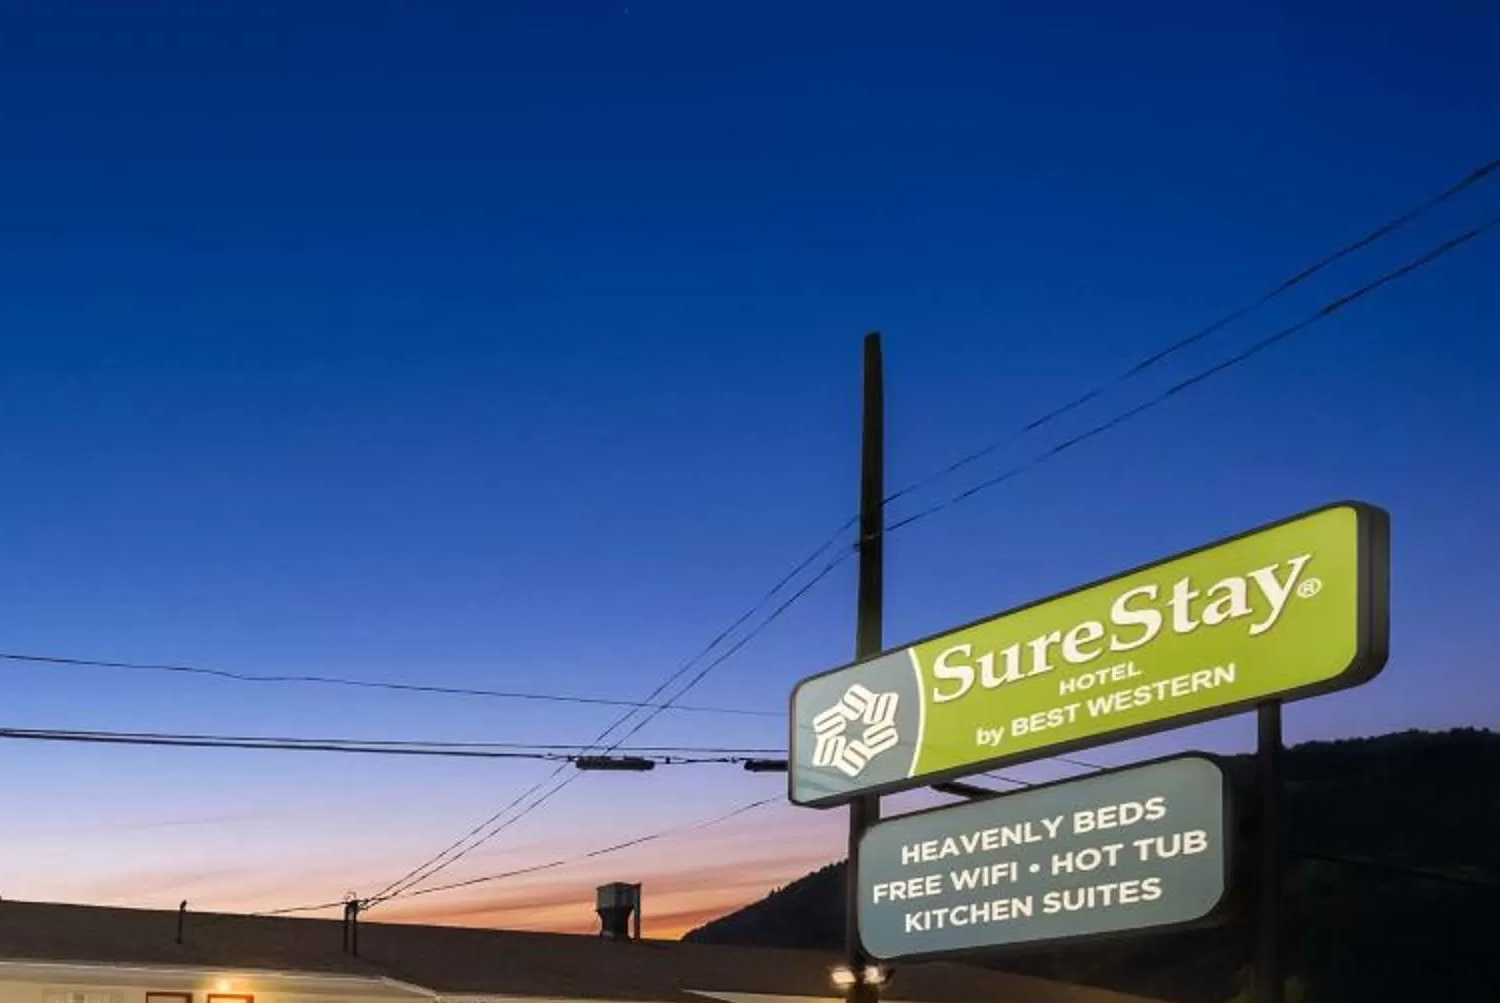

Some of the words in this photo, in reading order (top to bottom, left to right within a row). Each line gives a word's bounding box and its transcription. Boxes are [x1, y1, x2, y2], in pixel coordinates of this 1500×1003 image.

[976, 723, 1005, 747] by
[1011, 703, 1079, 737] BEST
[1088, 662, 1236, 718] WESTERN
[1059, 662, 1141, 696] HOTEL
[901, 816, 1063, 865] HEAVENLY
[1074, 796, 1167, 834] BEDS
[872, 874, 942, 905] FREE
[950, 861, 1018, 893] WIFI
[1051, 845, 1122, 876] HOT
[1133, 829, 1208, 859] TUB
[904, 897, 1033, 933] KITCHEN
[1042, 877, 1162, 914] SUITES
